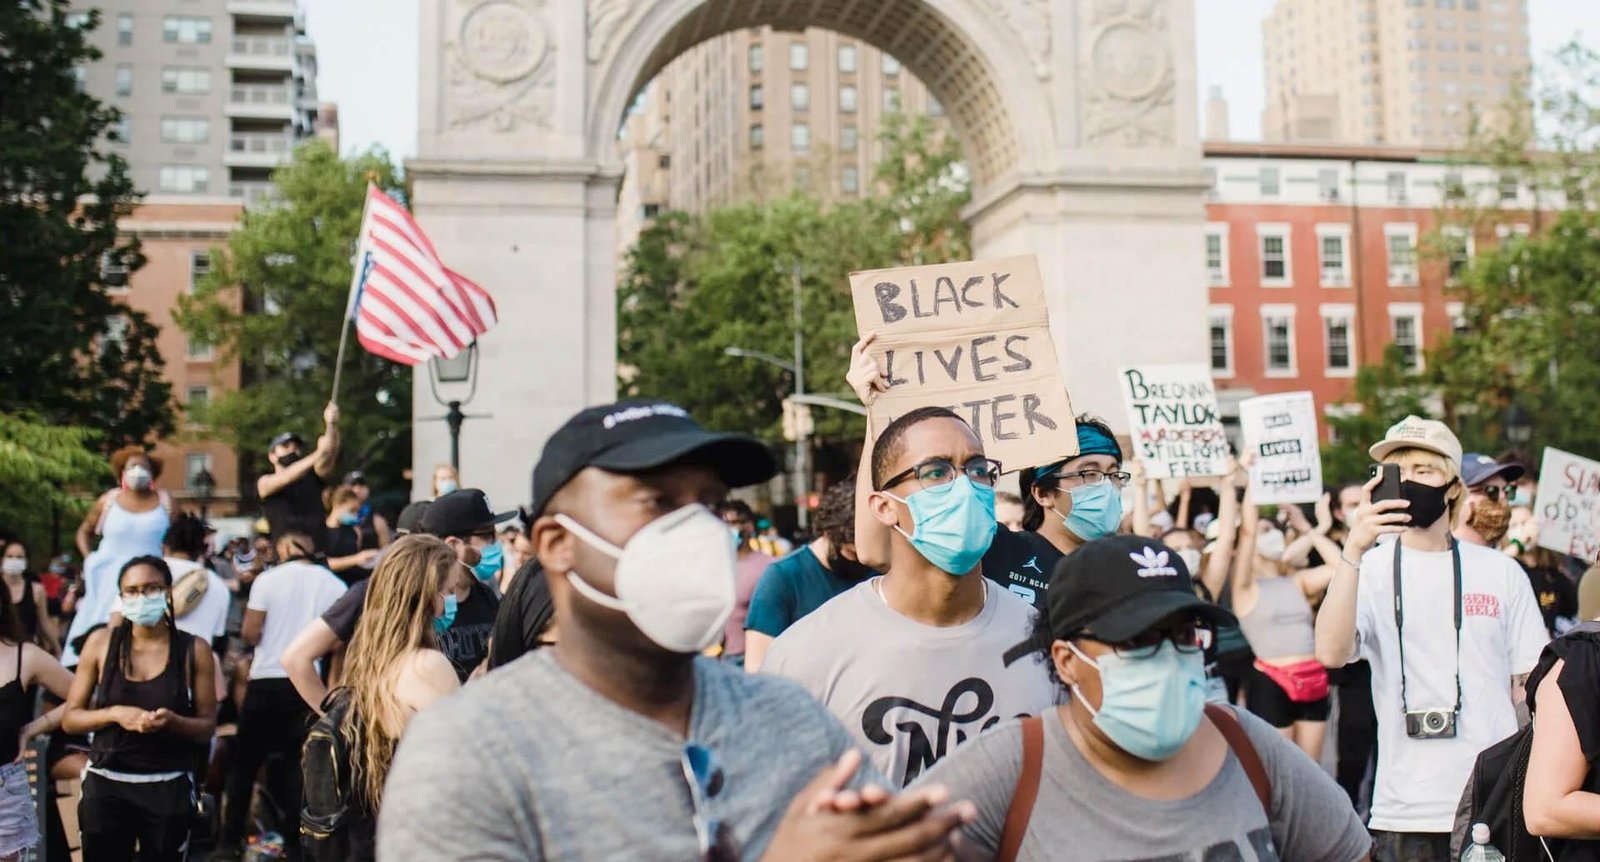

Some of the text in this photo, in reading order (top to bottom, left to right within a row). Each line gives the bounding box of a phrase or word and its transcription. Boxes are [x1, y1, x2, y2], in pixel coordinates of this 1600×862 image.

[873, 272, 1020, 324] BLACK
[885, 334, 1033, 386] LIVES
[1133, 403, 1218, 425] TAYLOR
[1143, 442, 1190, 459] STILL
[1009, 571, 1027, 583] 2017
